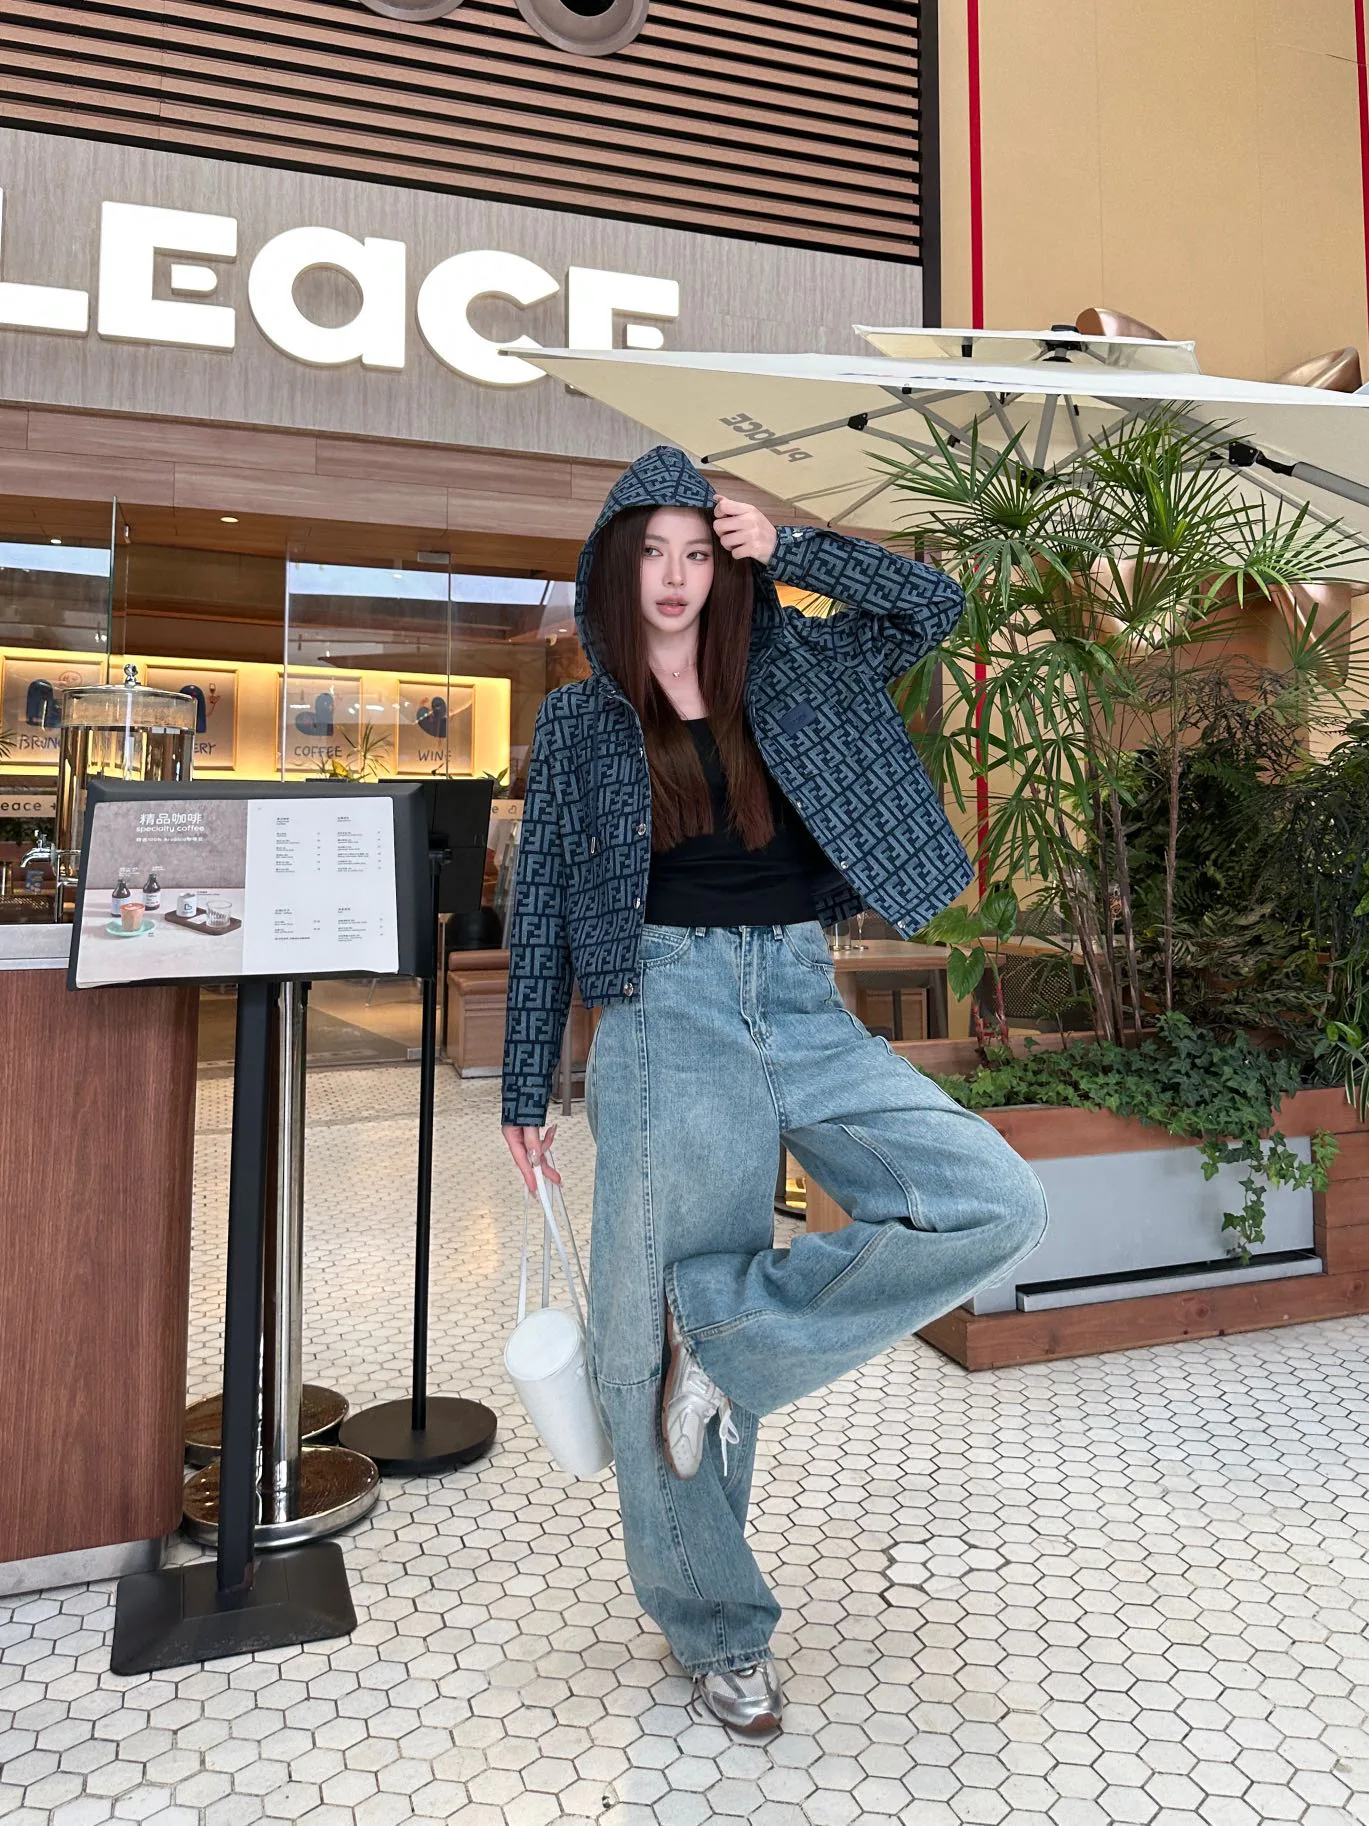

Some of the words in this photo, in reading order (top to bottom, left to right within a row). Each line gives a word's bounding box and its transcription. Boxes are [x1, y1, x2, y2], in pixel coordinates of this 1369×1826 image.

[20, 734, 60, 750] BRUN
[294, 745, 342, 759] COFFEE
[139, 812, 203, 825] 精品咖啡
[136, 825, 175, 833] specialty
